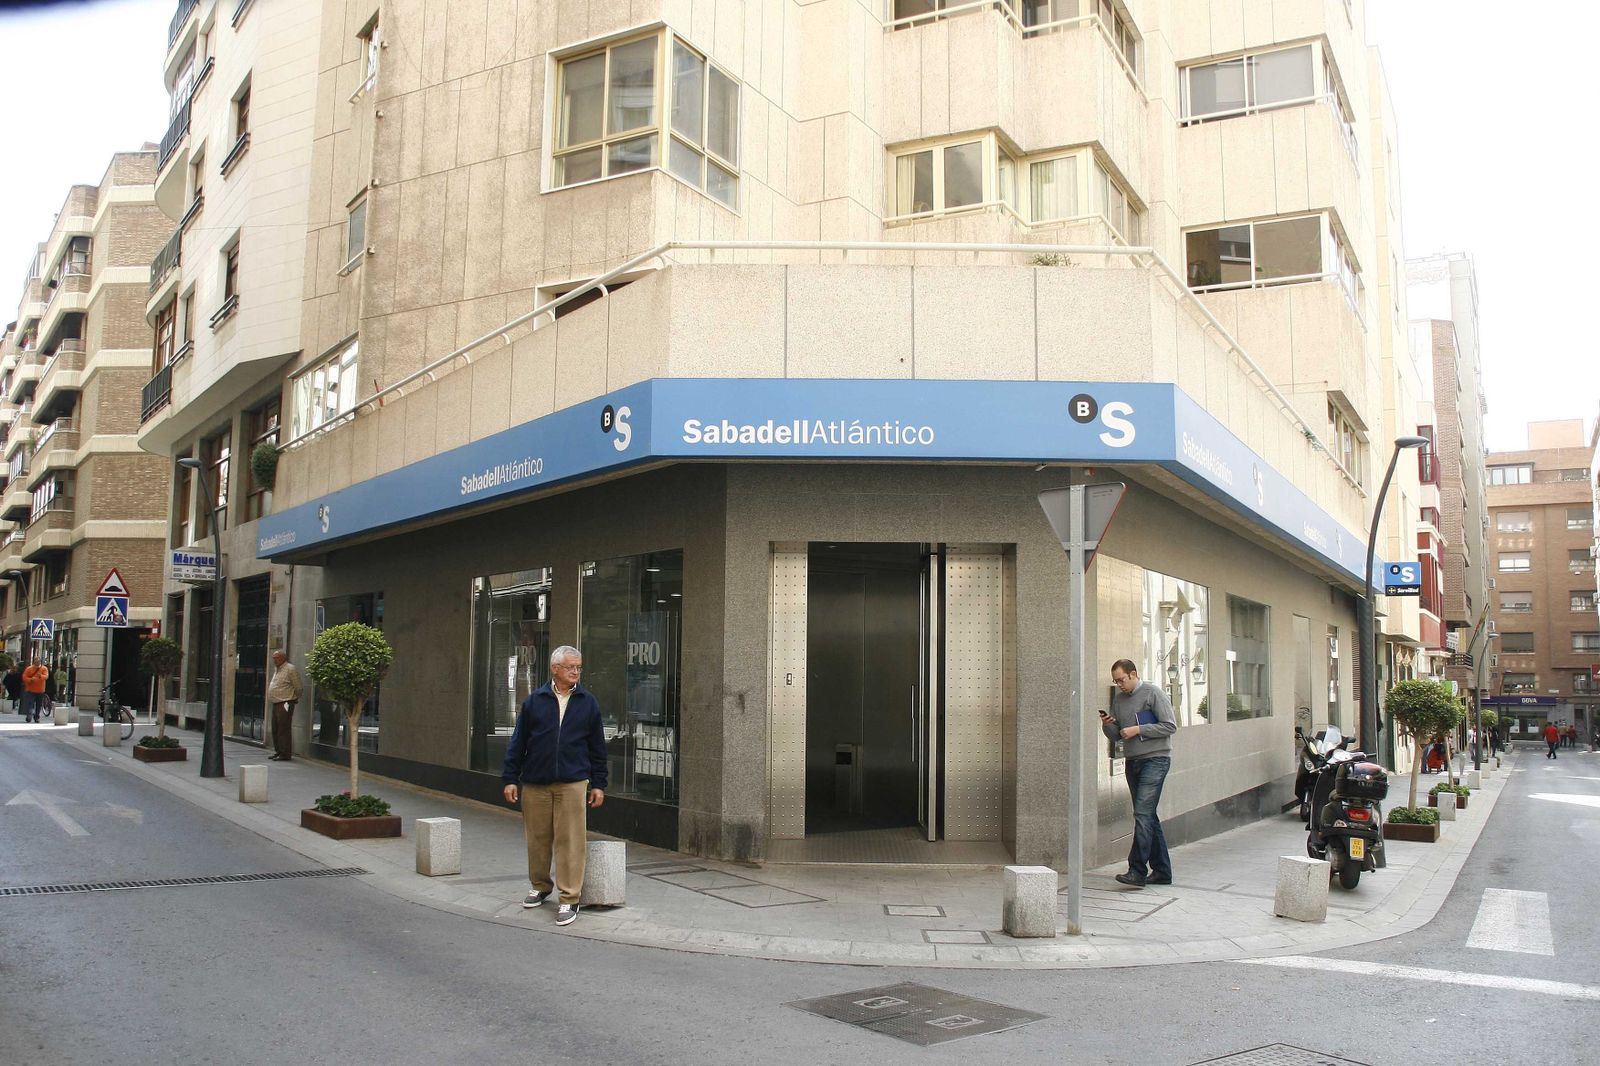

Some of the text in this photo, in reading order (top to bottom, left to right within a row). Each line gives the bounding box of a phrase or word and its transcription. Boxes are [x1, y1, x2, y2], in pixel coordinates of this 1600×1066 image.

[682, 419, 935, 445] SabadellAtlántico
[460, 456, 544, 495] SabadellAtlántico
[173, 552, 217, 567] Márque
[627, 641, 661, 665] PRO
